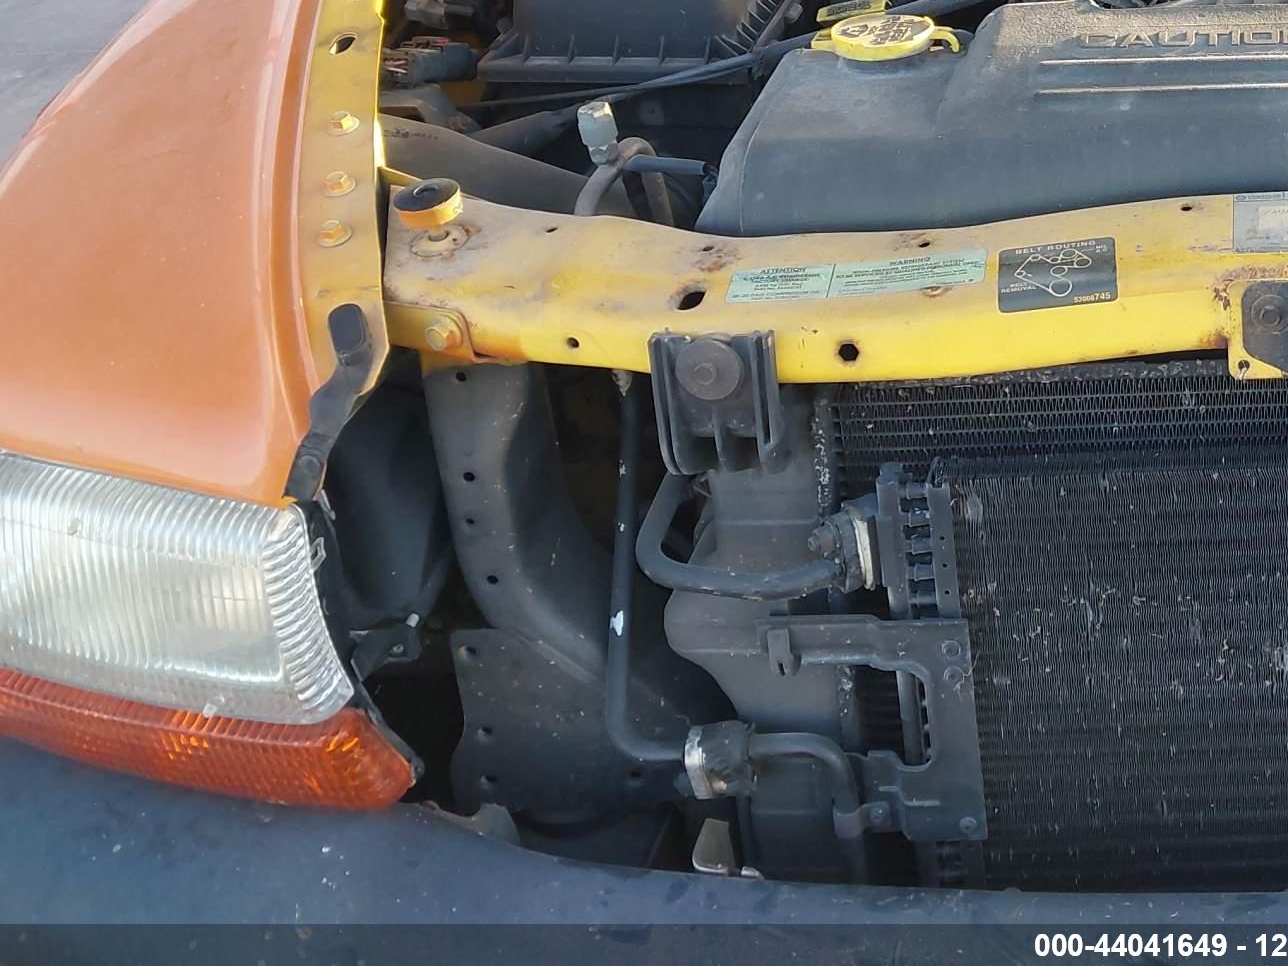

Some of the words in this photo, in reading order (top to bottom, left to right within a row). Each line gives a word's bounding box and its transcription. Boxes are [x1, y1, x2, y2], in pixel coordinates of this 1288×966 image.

[1015, 246, 1042, 255] BELT
[1047, 240, 1096, 251] ROUTING
[889, 256, 931, 266] WARNING
[1001, 285, 1037, 294] REMOVAL
